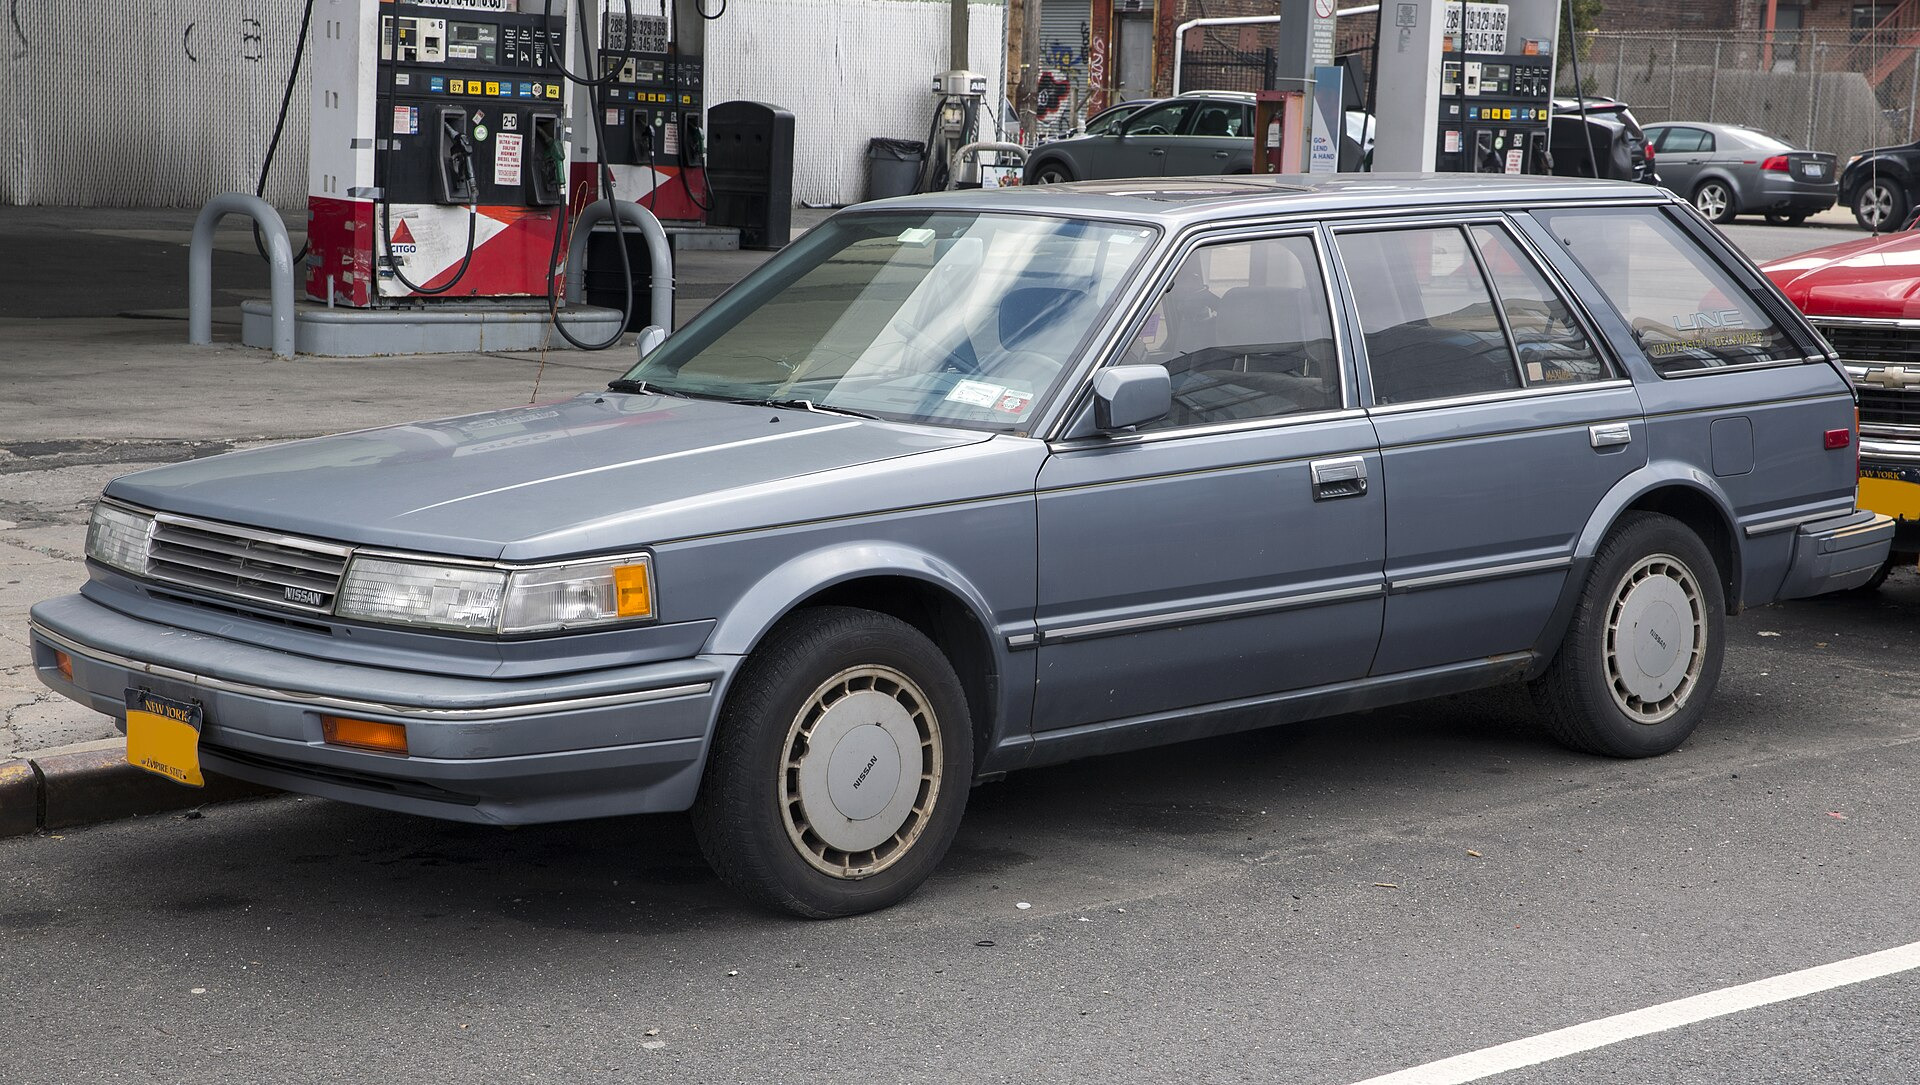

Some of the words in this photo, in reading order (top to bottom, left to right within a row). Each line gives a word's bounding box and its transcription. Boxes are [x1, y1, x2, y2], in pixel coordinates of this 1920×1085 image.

[438, 21, 443, 30] 6
[610, 19, 622, 33] 289
[640, 20, 652, 35] 329
[653, 21, 666, 36] 369
[1446, 10, 1458, 28] 289
[1476, 11, 1489, 30] 329
[1491, 12, 1506, 31] 369
[639, 36, 651, 51] 345
[1475, 33, 1487, 51] 345
[1490, 33, 1503, 52] 385
[452, 84, 461, 92] 87
[971, 82, 986, 91] AIR
[503, 116, 516, 127] 2-D
[391, 244, 416, 254] CITGO
[1673, 309, 1743, 332] UNC
[1652, 338, 1706, 356] UNIVERSITY
[1715, 331, 1764, 348] DELAWARE
[1876, 470, 1900, 480] YORK
[284, 587, 321, 605] NISSAN
[1649, 628, 1667, 650] NISSAN
[145, 700, 164, 714] NEW
[165, 704, 188, 722] YORK
[146, 757, 168, 773] EMPIRE
[169, 766, 183, 779] STATE
[852, 755, 879, 790] NISSAN
